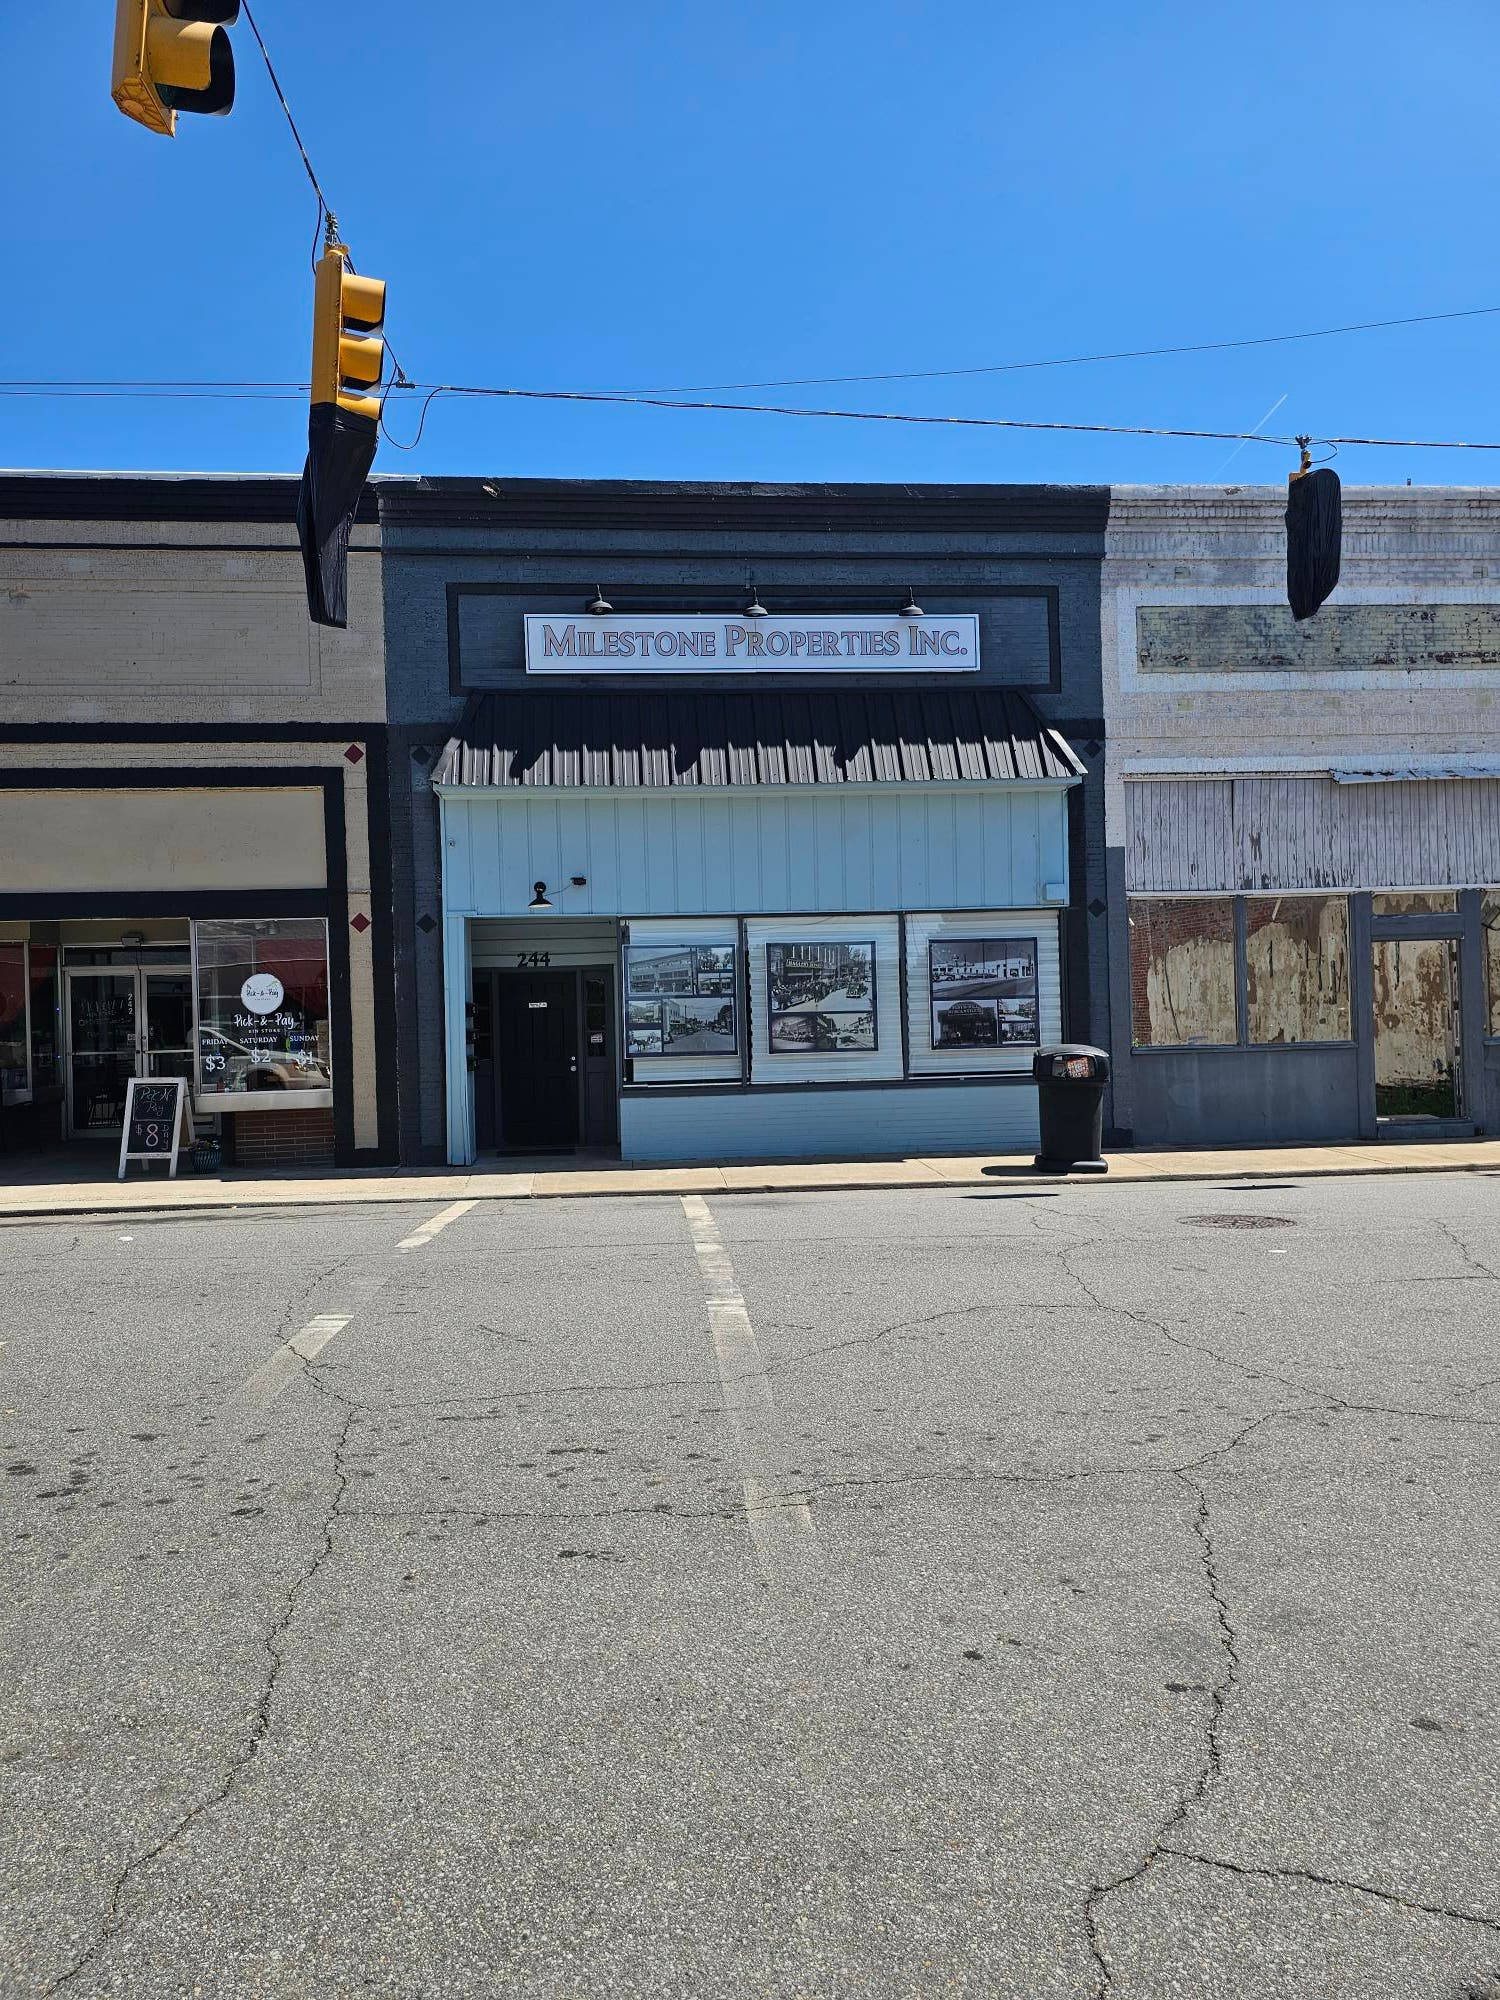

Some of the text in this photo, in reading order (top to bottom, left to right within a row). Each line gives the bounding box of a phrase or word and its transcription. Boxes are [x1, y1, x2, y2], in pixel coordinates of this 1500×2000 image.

[517, 951, 551, 968] 244
[233, 1012, 295, 1030] Pick-&-Pay
[201, 1034, 320, 1046] FRIDAY SATURDAY SUNDAY
[205, 1046, 315, 1073] $3 $2 $1
